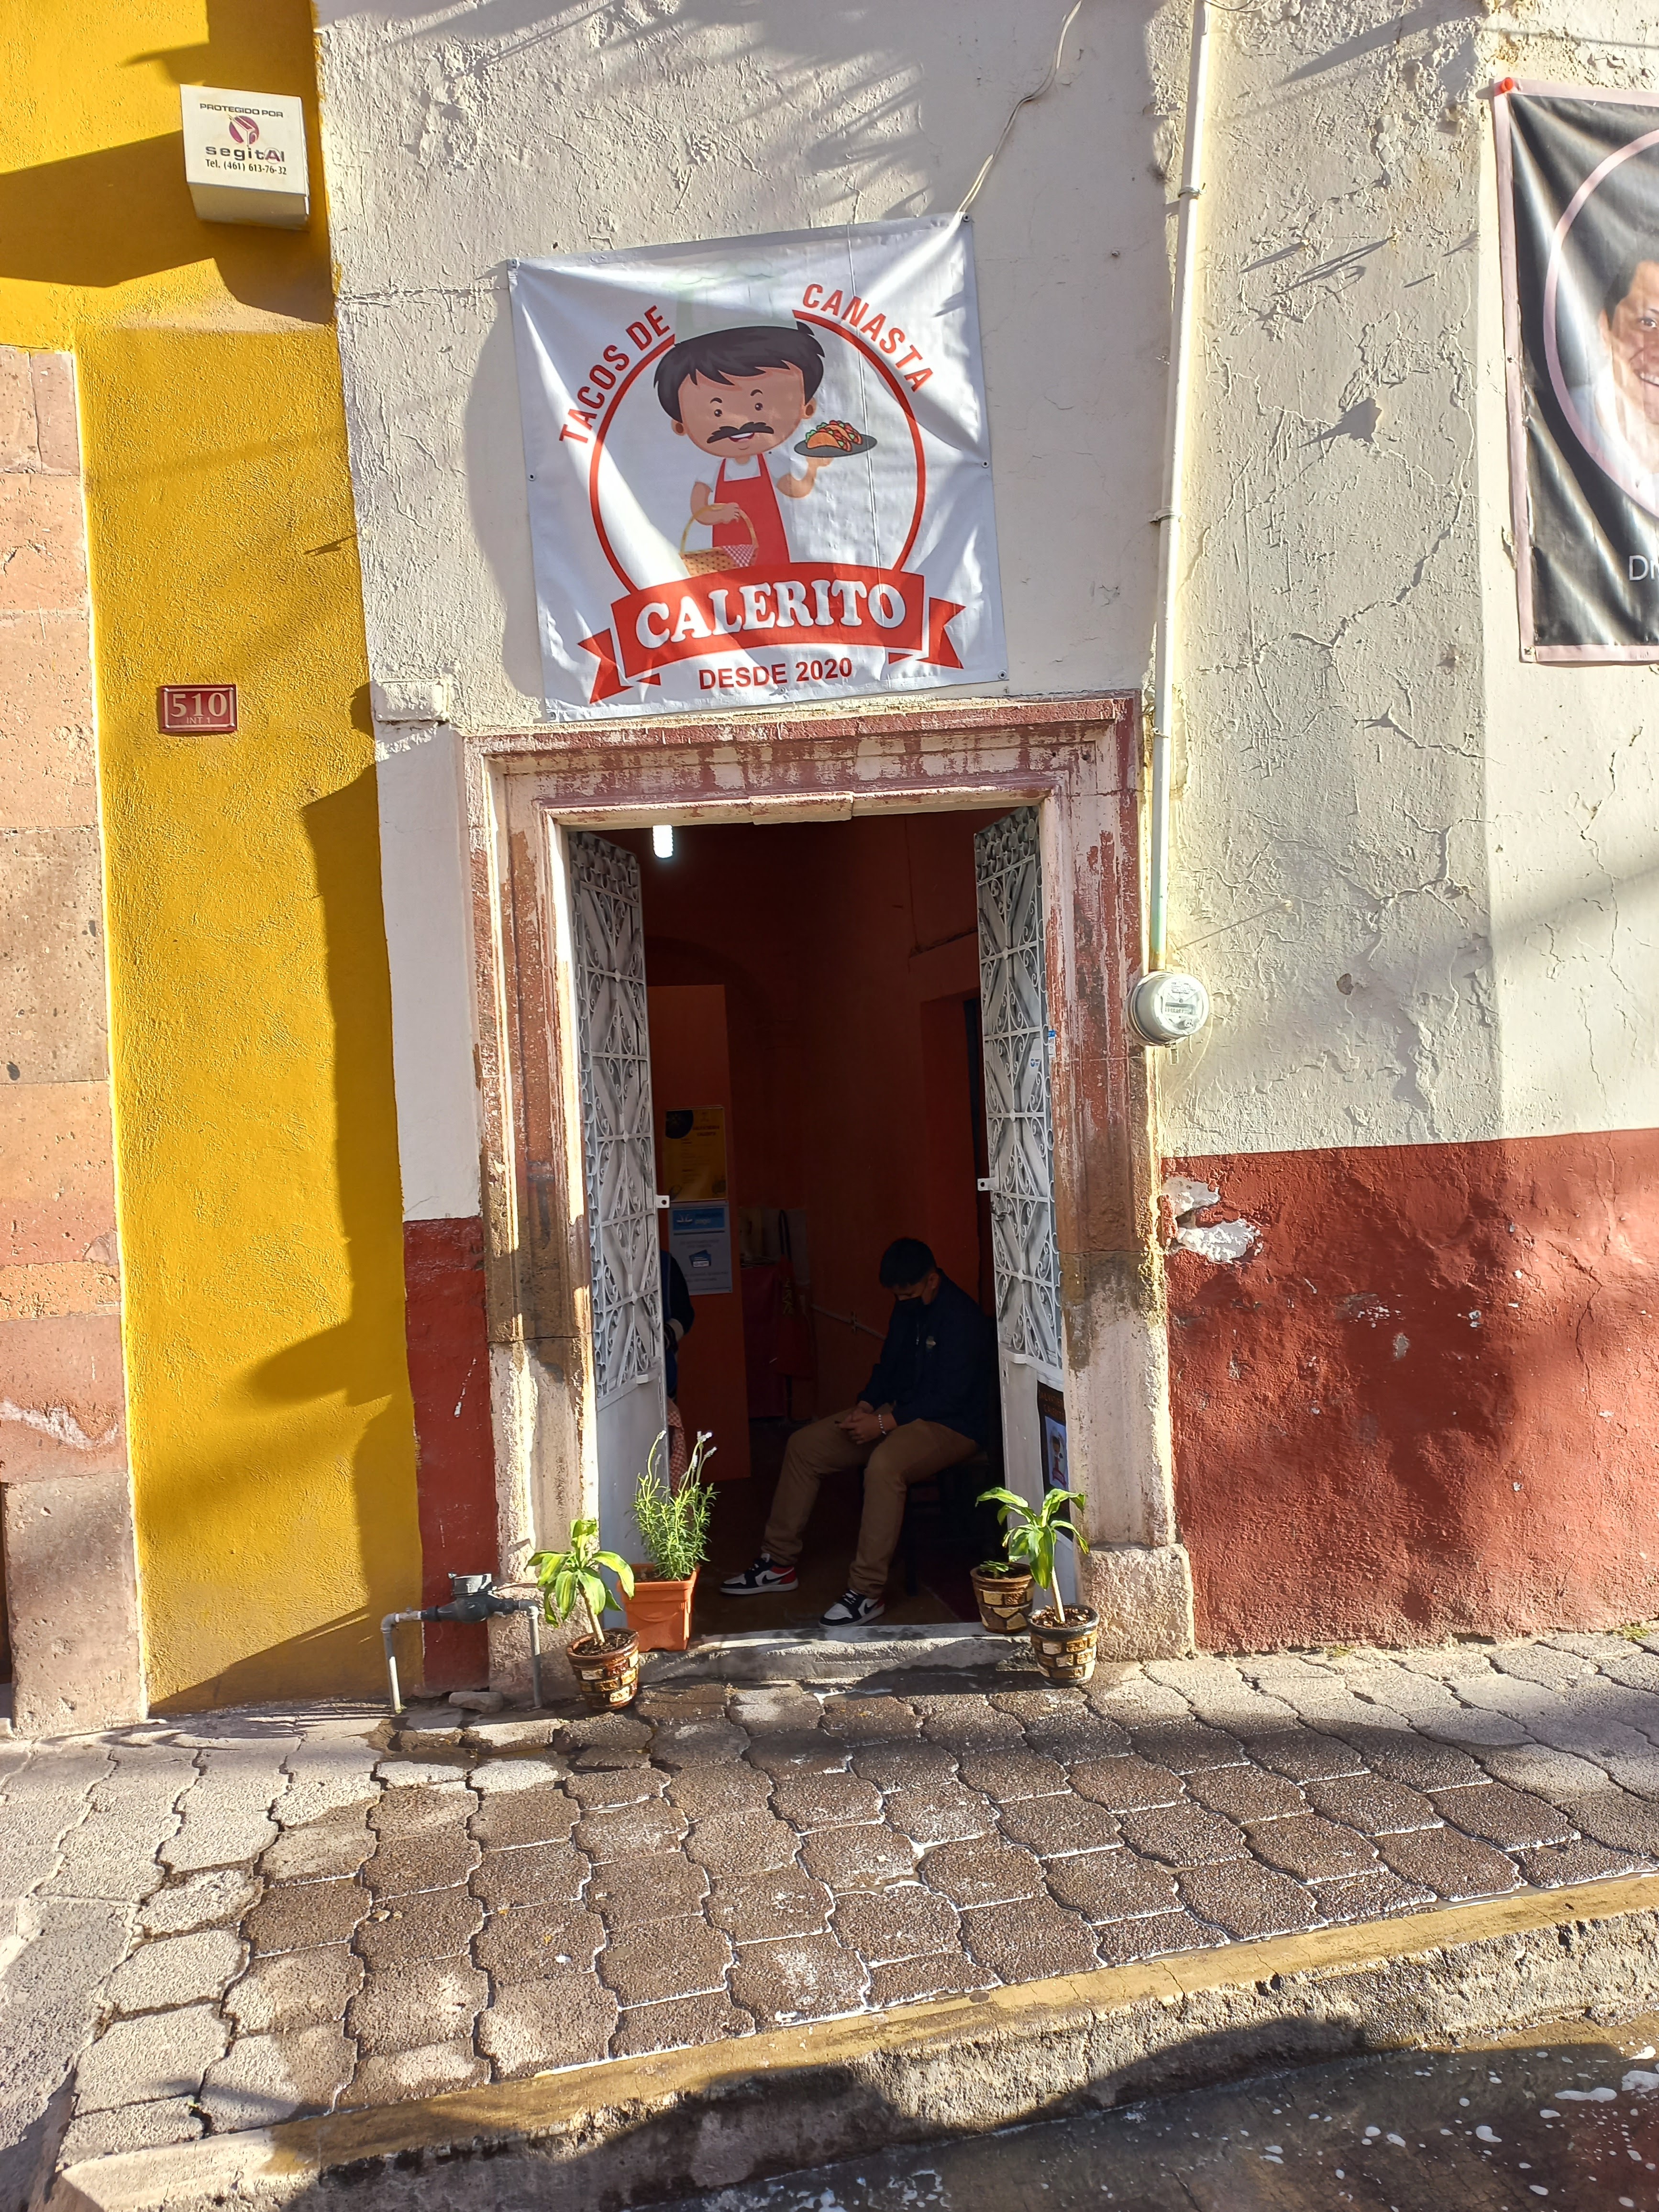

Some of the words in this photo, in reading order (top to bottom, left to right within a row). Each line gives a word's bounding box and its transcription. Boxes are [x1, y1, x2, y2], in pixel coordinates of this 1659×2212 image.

[200, 103, 260, 115] PROTEGIDO
[262, 110, 284, 118] POR
[205, 158, 221, 168] Tel.
[223, 160, 245, 172] (461)
[249, 163, 287, 175] 613-76-32
[802, 283, 933, 393] CANASTA
[559, 344, 630, 444] TACOS
[625, 305, 671, 351] DE
[635, 579, 907, 649] CALERITO
[699, 663, 788, 690] DESDE
[795, 657, 852, 682] 2020
[170, 692, 228, 718] 510
